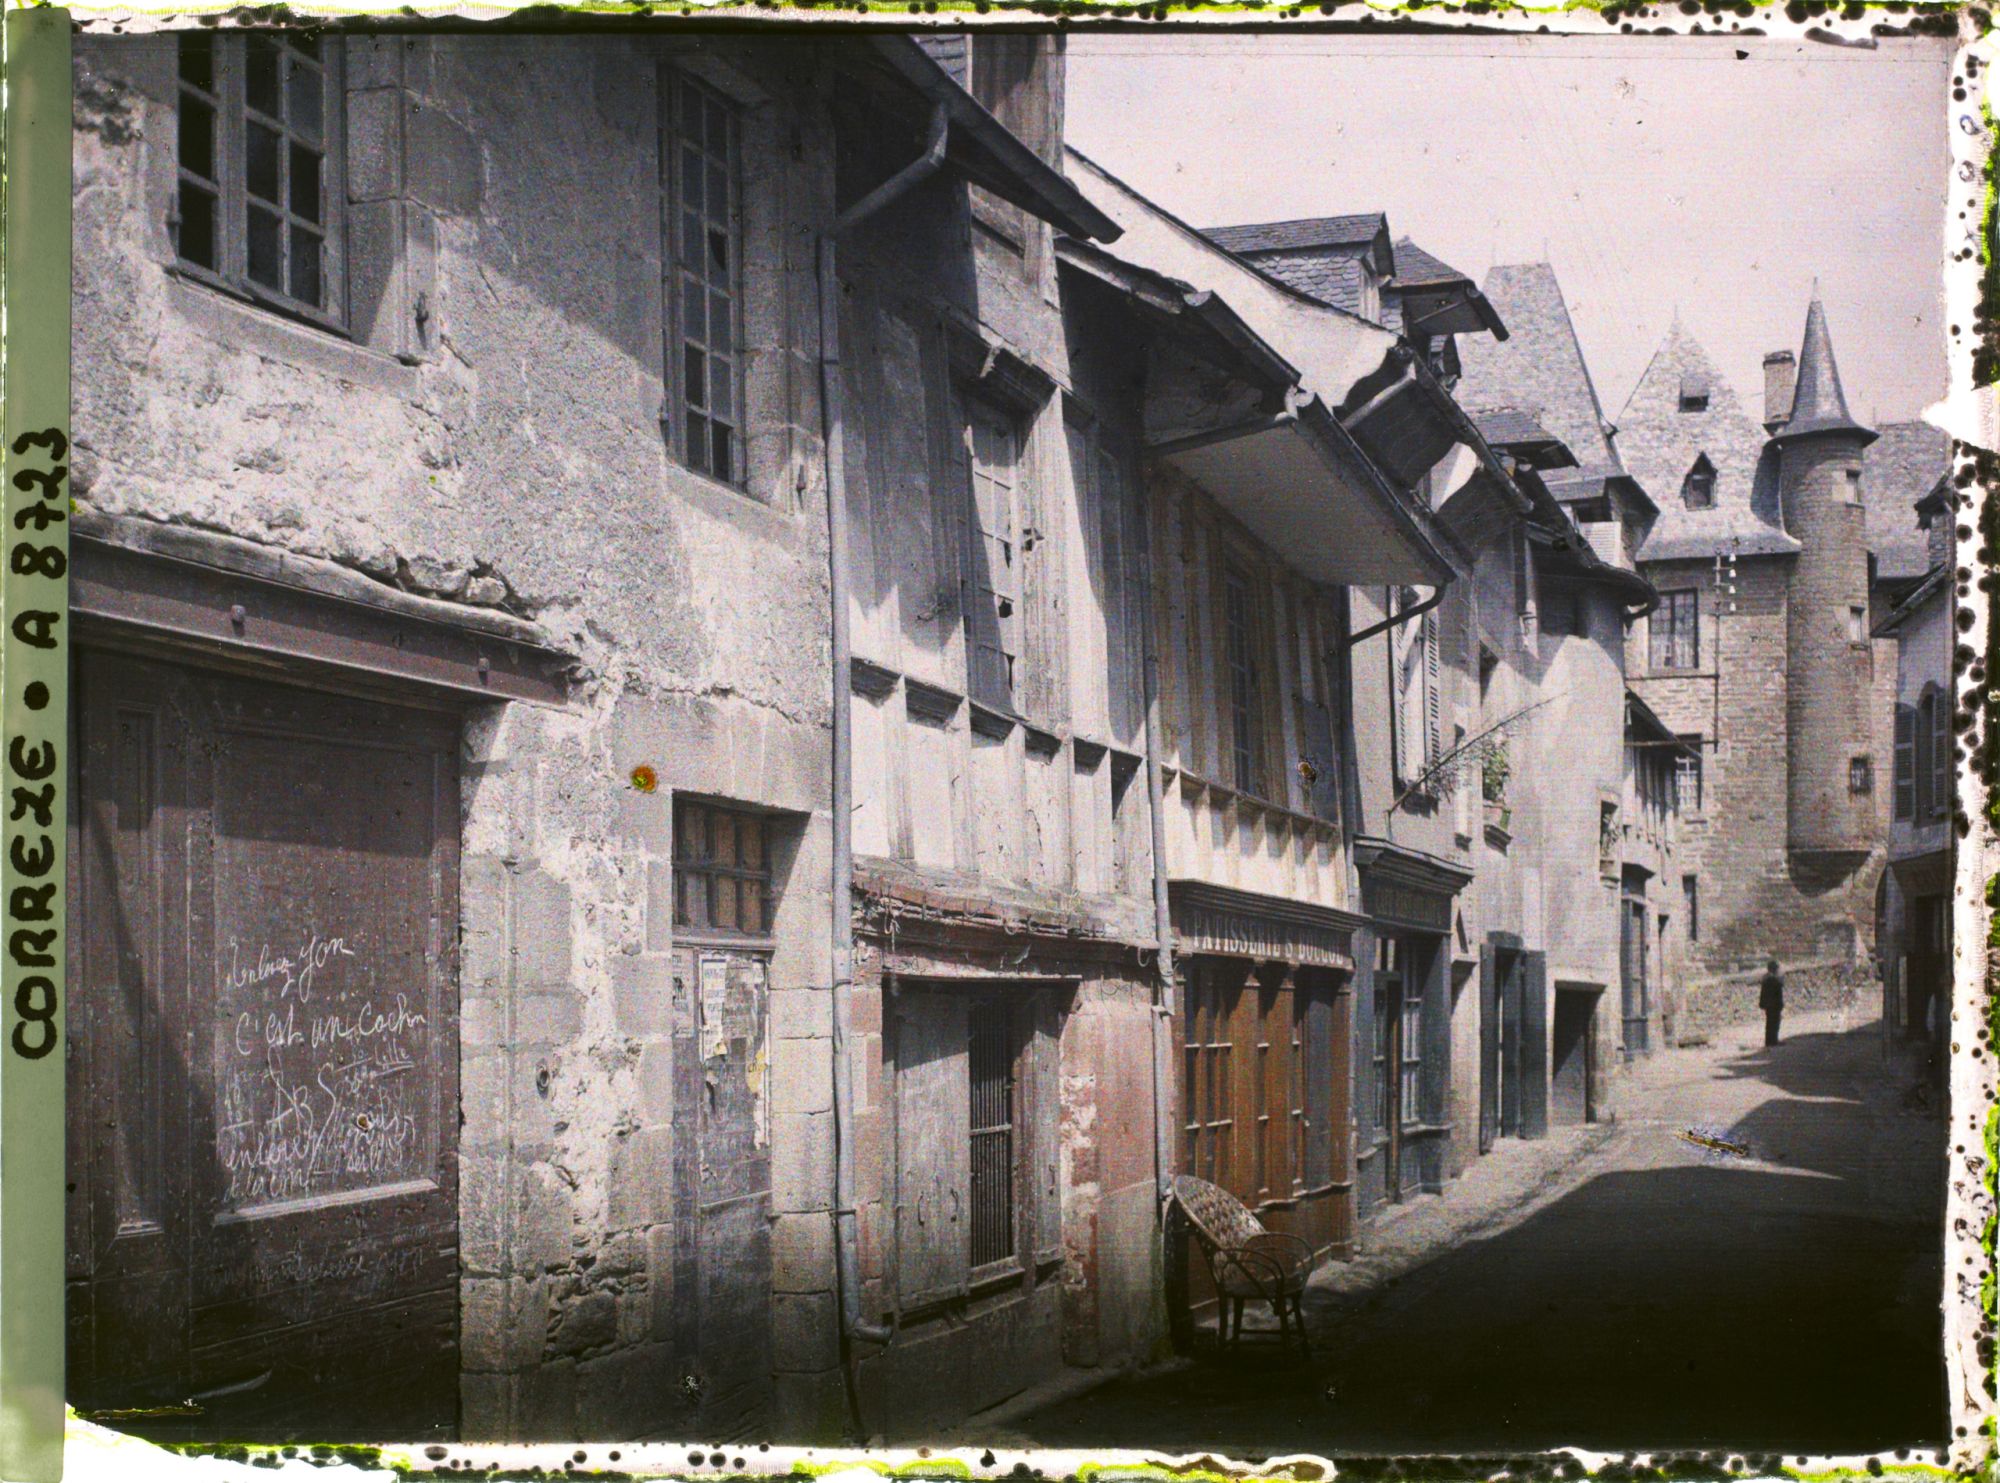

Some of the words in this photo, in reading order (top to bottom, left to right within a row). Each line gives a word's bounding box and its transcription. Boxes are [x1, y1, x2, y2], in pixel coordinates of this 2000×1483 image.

[11, 427, 67, 579] 8723
[12, 609, 60, 650] A
[9, 735, 57, 1060] CORREZE
[1193, 911, 1280, 957] PATISSERIE
